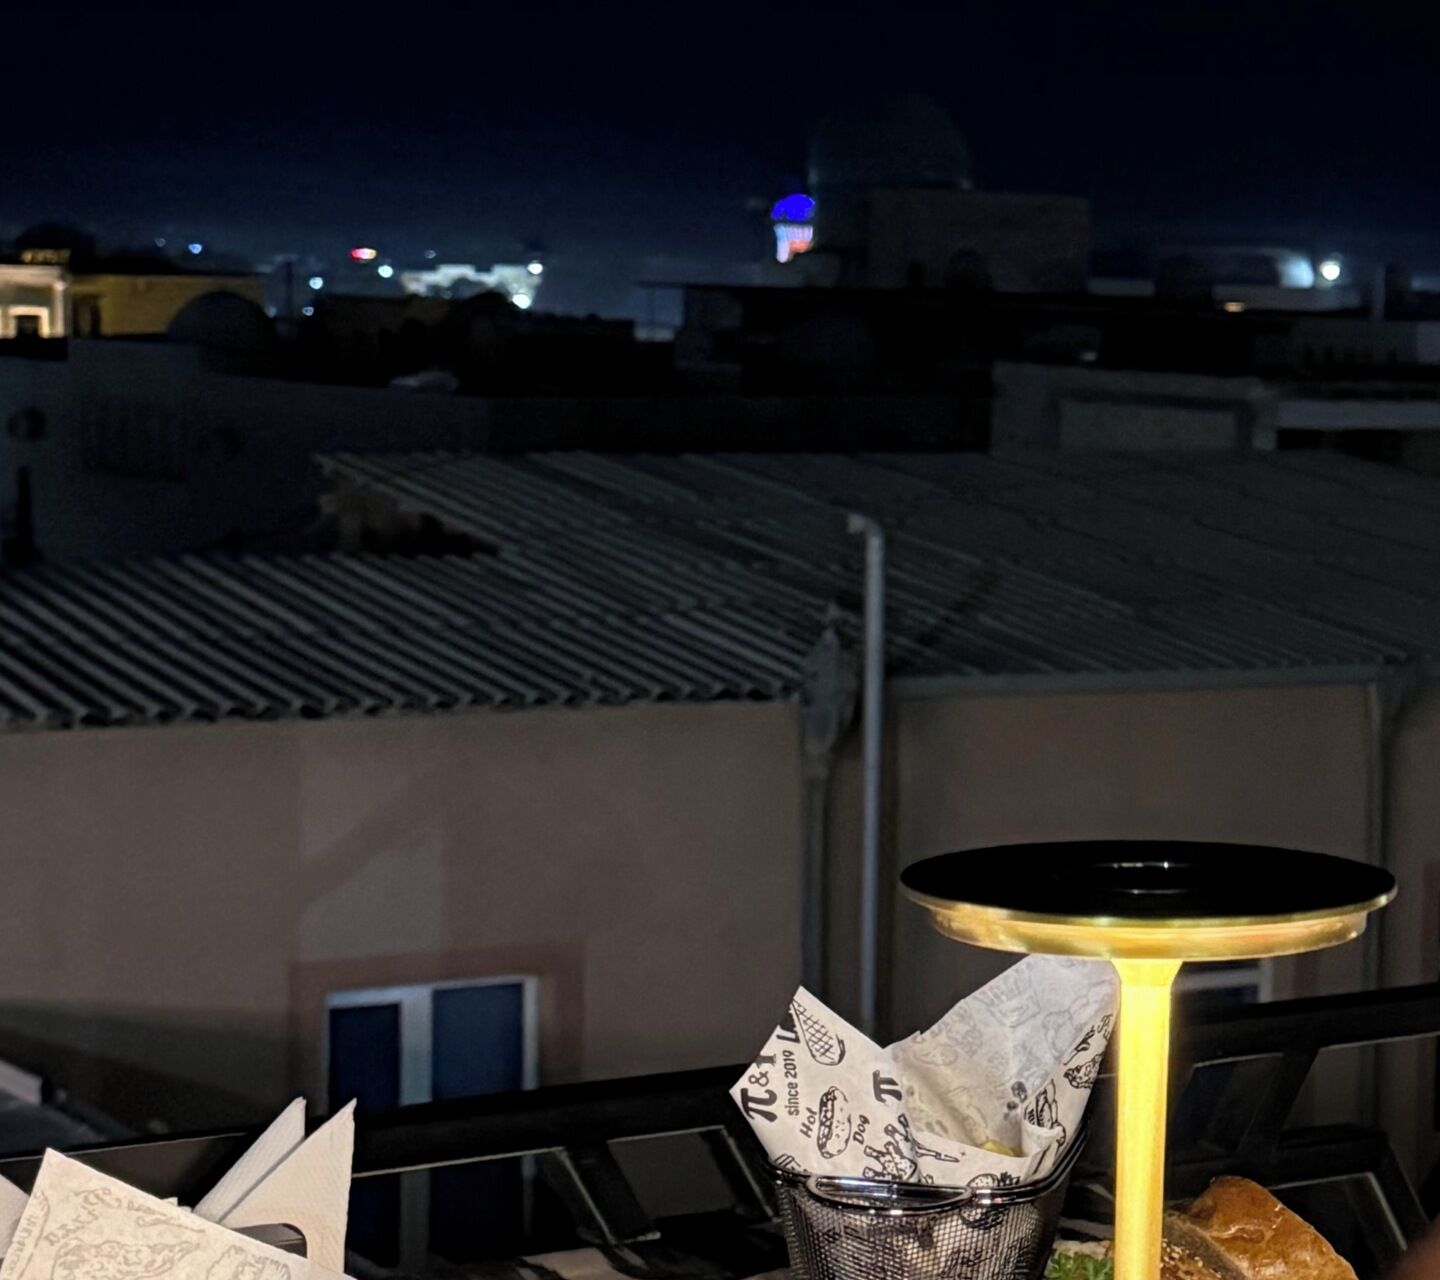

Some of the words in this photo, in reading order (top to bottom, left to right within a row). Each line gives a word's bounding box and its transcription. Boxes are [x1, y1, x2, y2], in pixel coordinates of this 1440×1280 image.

[783, 1049, 798, 1079] 2019
[785, 1079, 799, 1117] since
[852, 1114, 871, 1146] Dog
